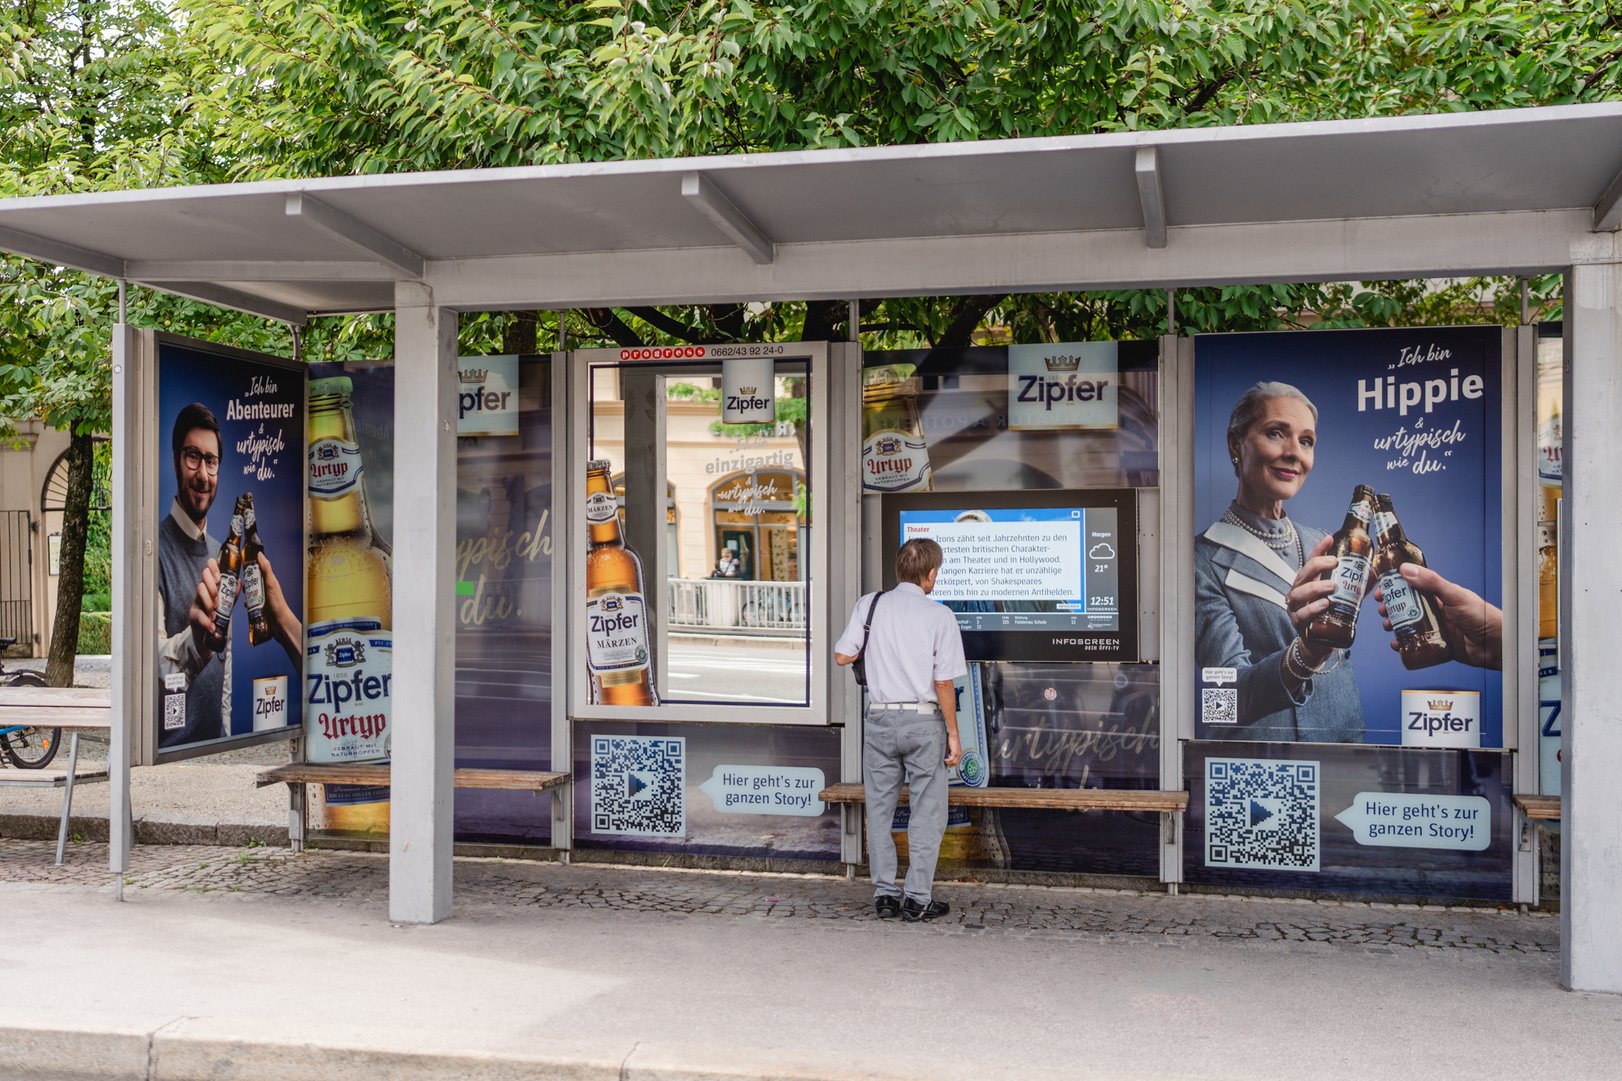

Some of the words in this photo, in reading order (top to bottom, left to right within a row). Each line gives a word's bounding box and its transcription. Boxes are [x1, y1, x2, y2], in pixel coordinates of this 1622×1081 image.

[620, 346, 705, 360] progress
[710, 346, 747, 357] 0662/43
[749, 346, 761, 356] 92
[763, 345, 783, 355] 24-0
[1426, 343, 1452, 361] bin
[264, 376, 278, 394] bin
[1016, 373, 1109, 411] Zipfer
[1358, 368, 1484, 416] Hippie
[226, 398, 295, 421] Abenteurer
[458, 386, 511, 419] pfer
[726, 395, 771, 414] Zipfer
[258, 422, 265, 434] &
[1414, 416, 1424, 429] &
[236, 429, 286, 463] urtypisch
[1373, 419, 1466, 457] urtypisch
[243, 462, 257, 475] wie
[310, 462, 348, 478] Urtyp
[705, 450, 795, 475] einzigartig
[867, 458, 912, 475] Urtyp
[1386, 456, 1410, 470] wie
[719, 479, 778, 504] urtypisch
[936, 535, 956, 543] Irons
[957, 535, 975, 543] zählt
[977, 535, 991, 543] seit
[992, 534, 1040, 543] Jahrzehnten
[972, 545, 1009, 553] britischen
[1011, 544, 1051, 552] Charakter-
[963, 556, 991, 564] Theater
[1019, 556, 1062, 564] Hollywood.
[1094, 564, 1109, 573] 21°
[941, 567, 967, 576] langen
[968, 567, 997, 575] Karriere
[1025, 567, 1062, 576] unzählige
[935, 578, 973, 586] erkörpert,
[990, 578, 1042, 586] Shakespeares
[990, 588, 1030, 596] modernen
[1031, 588, 1074, 596] Antihelden.
[1090, 596, 1114, 606] 12:51
[590, 613, 639, 637] Zipfer
[597, 636, 638, 650] MÄRZEN
[307, 669, 391, 714] Zipfer
[256, 697, 285, 719] Zipfer
[318, 713, 387, 740] Urtyp
[1408, 711, 1473, 737] Zipfer
[331, 749, 381, 758] NATURHOPFEN
[332, 743, 363, 752] GEBRAUT
[723, 773, 749, 786] Hier
[752, 775, 791, 790] geht's
[795, 779, 815, 789] zur
[725, 792, 770, 806] ganzen
[774, 791, 811, 809] Story!
[1366, 802, 1397, 816] Hier
[1402, 803, 1448, 820] geht's
[1454, 808, 1479, 820] zur
[1369, 823, 1423, 838] ganzen
[1429, 822, 1474, 842] Story!
